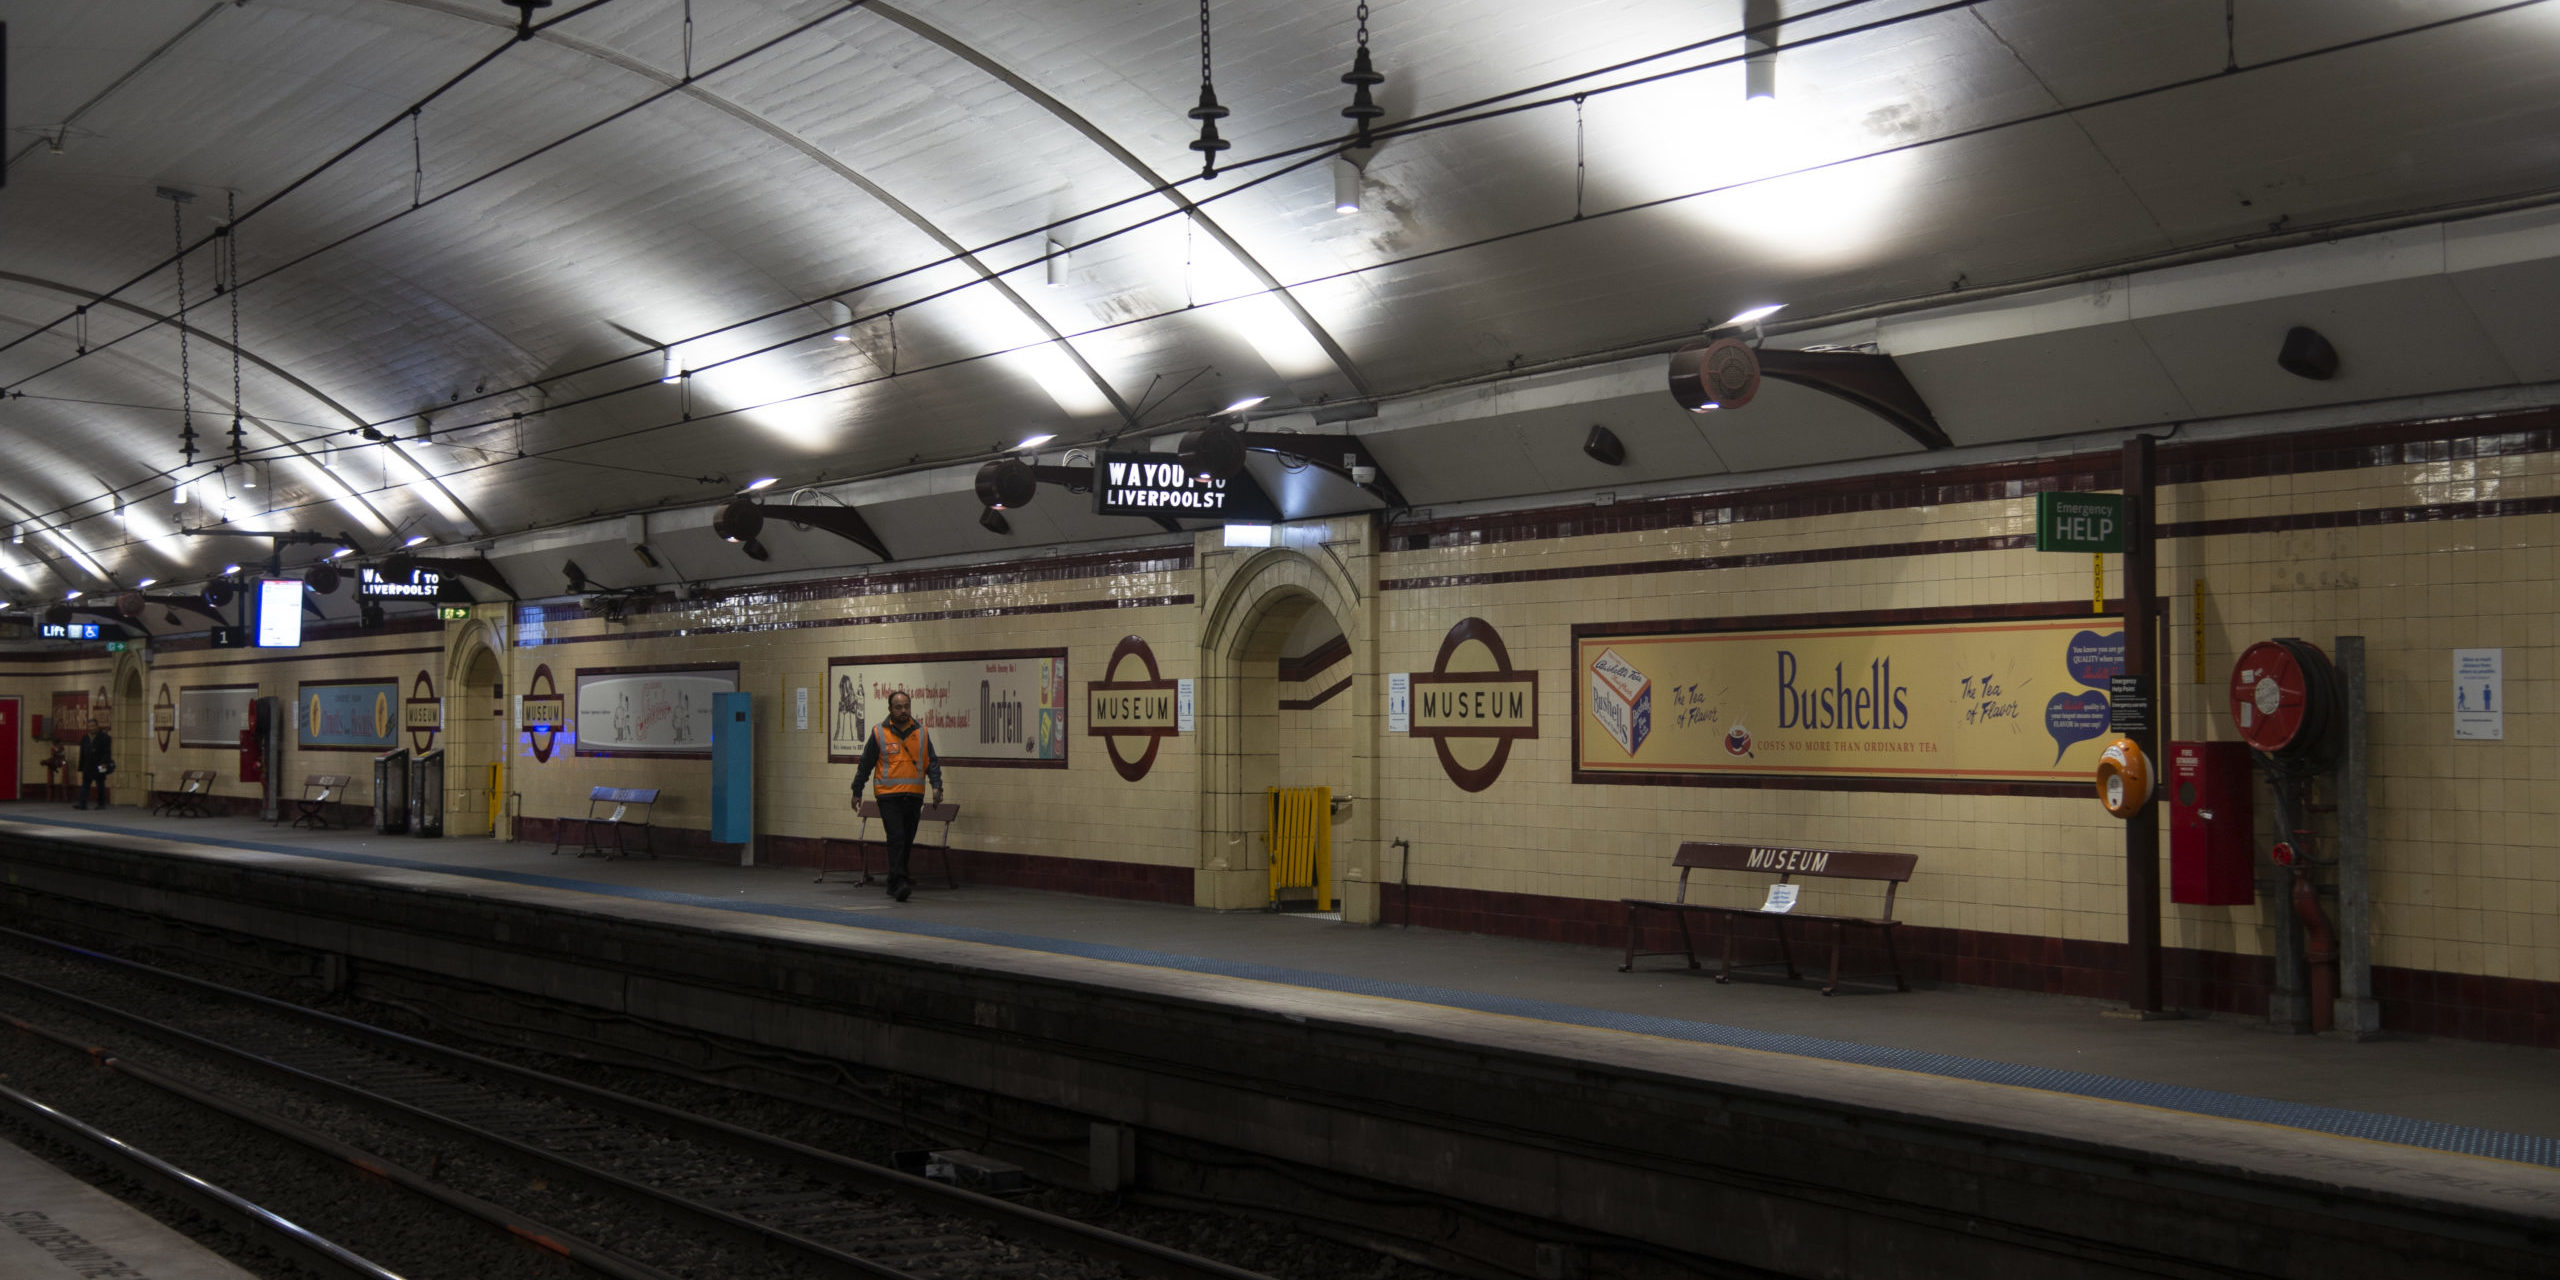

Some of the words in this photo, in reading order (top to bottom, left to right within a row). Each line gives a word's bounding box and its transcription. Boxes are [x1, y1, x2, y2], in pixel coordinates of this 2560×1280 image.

[2056, 502, 2113, 517] Emergency
[2056, 517, 2113, 541] HELP
[424, 574, 439, 584] TO
[43, 625, 65, 637] Lift
[218, 631, 228, 644] 1
[2073, 656, 2098, 664] QUALITY
[1673, 685, 1686, 705] The
[1688, 683, 1705, 705] Tea
[1777, 650, 1908, 731] Bushells
[1961, 677, 1977, 700] The
[1980, 674, 2002, 697] Tea
[409, 708, 437, 722] MUSEUM
[526, 705, 559, 721] MUSEUM
[980, 679, 1022, 744] Mortein
[1097, 696, 1168, 720] MUSEUM
[1424, 691, 1523, 719] MUSEUM
[1593, 686, 1628, 745] Bushells
[1966, 706, 1978, 725] of
[1981, 700, 2019, 724] Flavor
[1677, 711, 1686, 726] of
[1687, 707, 1718, 727] Flavor
[1757, 741, 1786, 752] COSTS
[1789, 741, 1802, 752] NO
[1805, 741, 1831, 752] MORE
[1834, 741, 1860, 752] THAN
[1864, 741, 1915, 753] ORDINARY
[1917, 742, 1938, 753] TEA
[1747, 848, 1829, 872] MUSEUM
